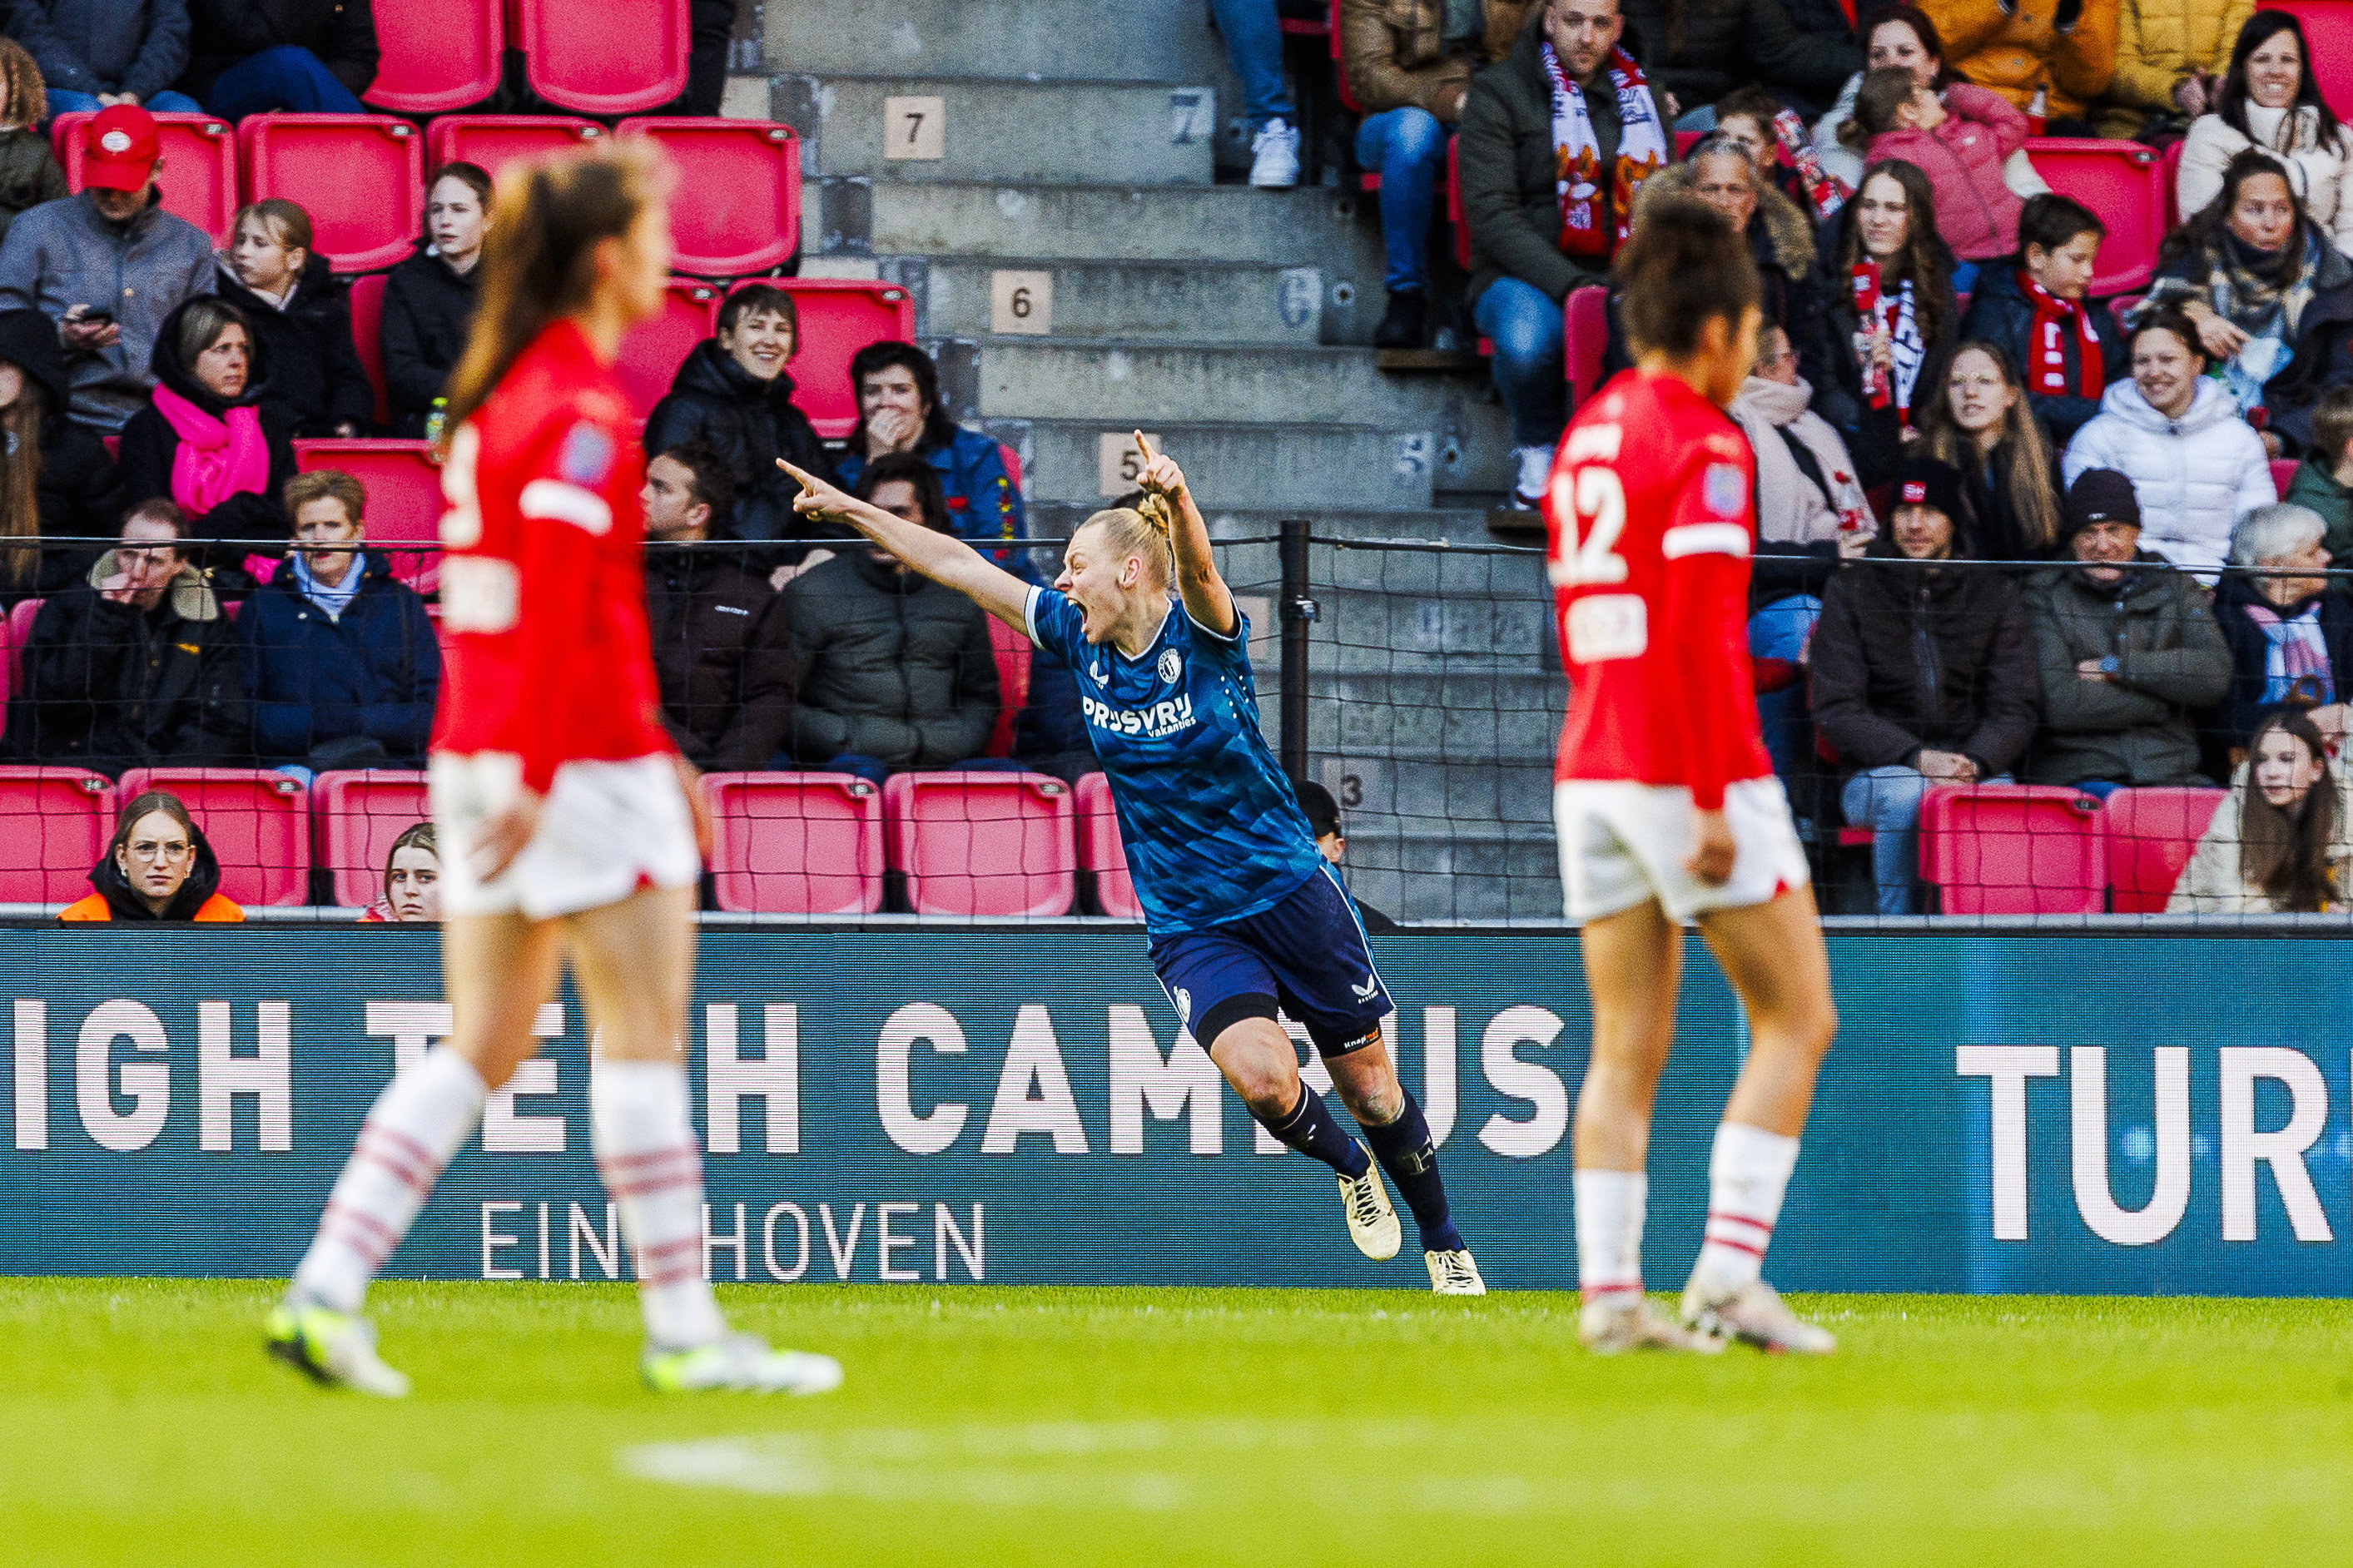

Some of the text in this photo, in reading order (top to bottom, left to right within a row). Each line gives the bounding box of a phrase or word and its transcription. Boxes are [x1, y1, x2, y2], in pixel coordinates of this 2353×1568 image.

[904, 112, 926, 145] 7
[1012, 285, 1031, 319] 6
[1120, 449, 1139, 481] 5
[1549, 465, 1628, 586] 12
[1147, 716, 1197, 739] vakanties
[1340, 773, 1363, 807] 3
[13, 998, 293, 1152] IGH
[365, 1000, 801, 1154] TEH
[1955, 1045, 2353, 1246] TUR
[481, 1200, 986, 1282] EINHOVEN
